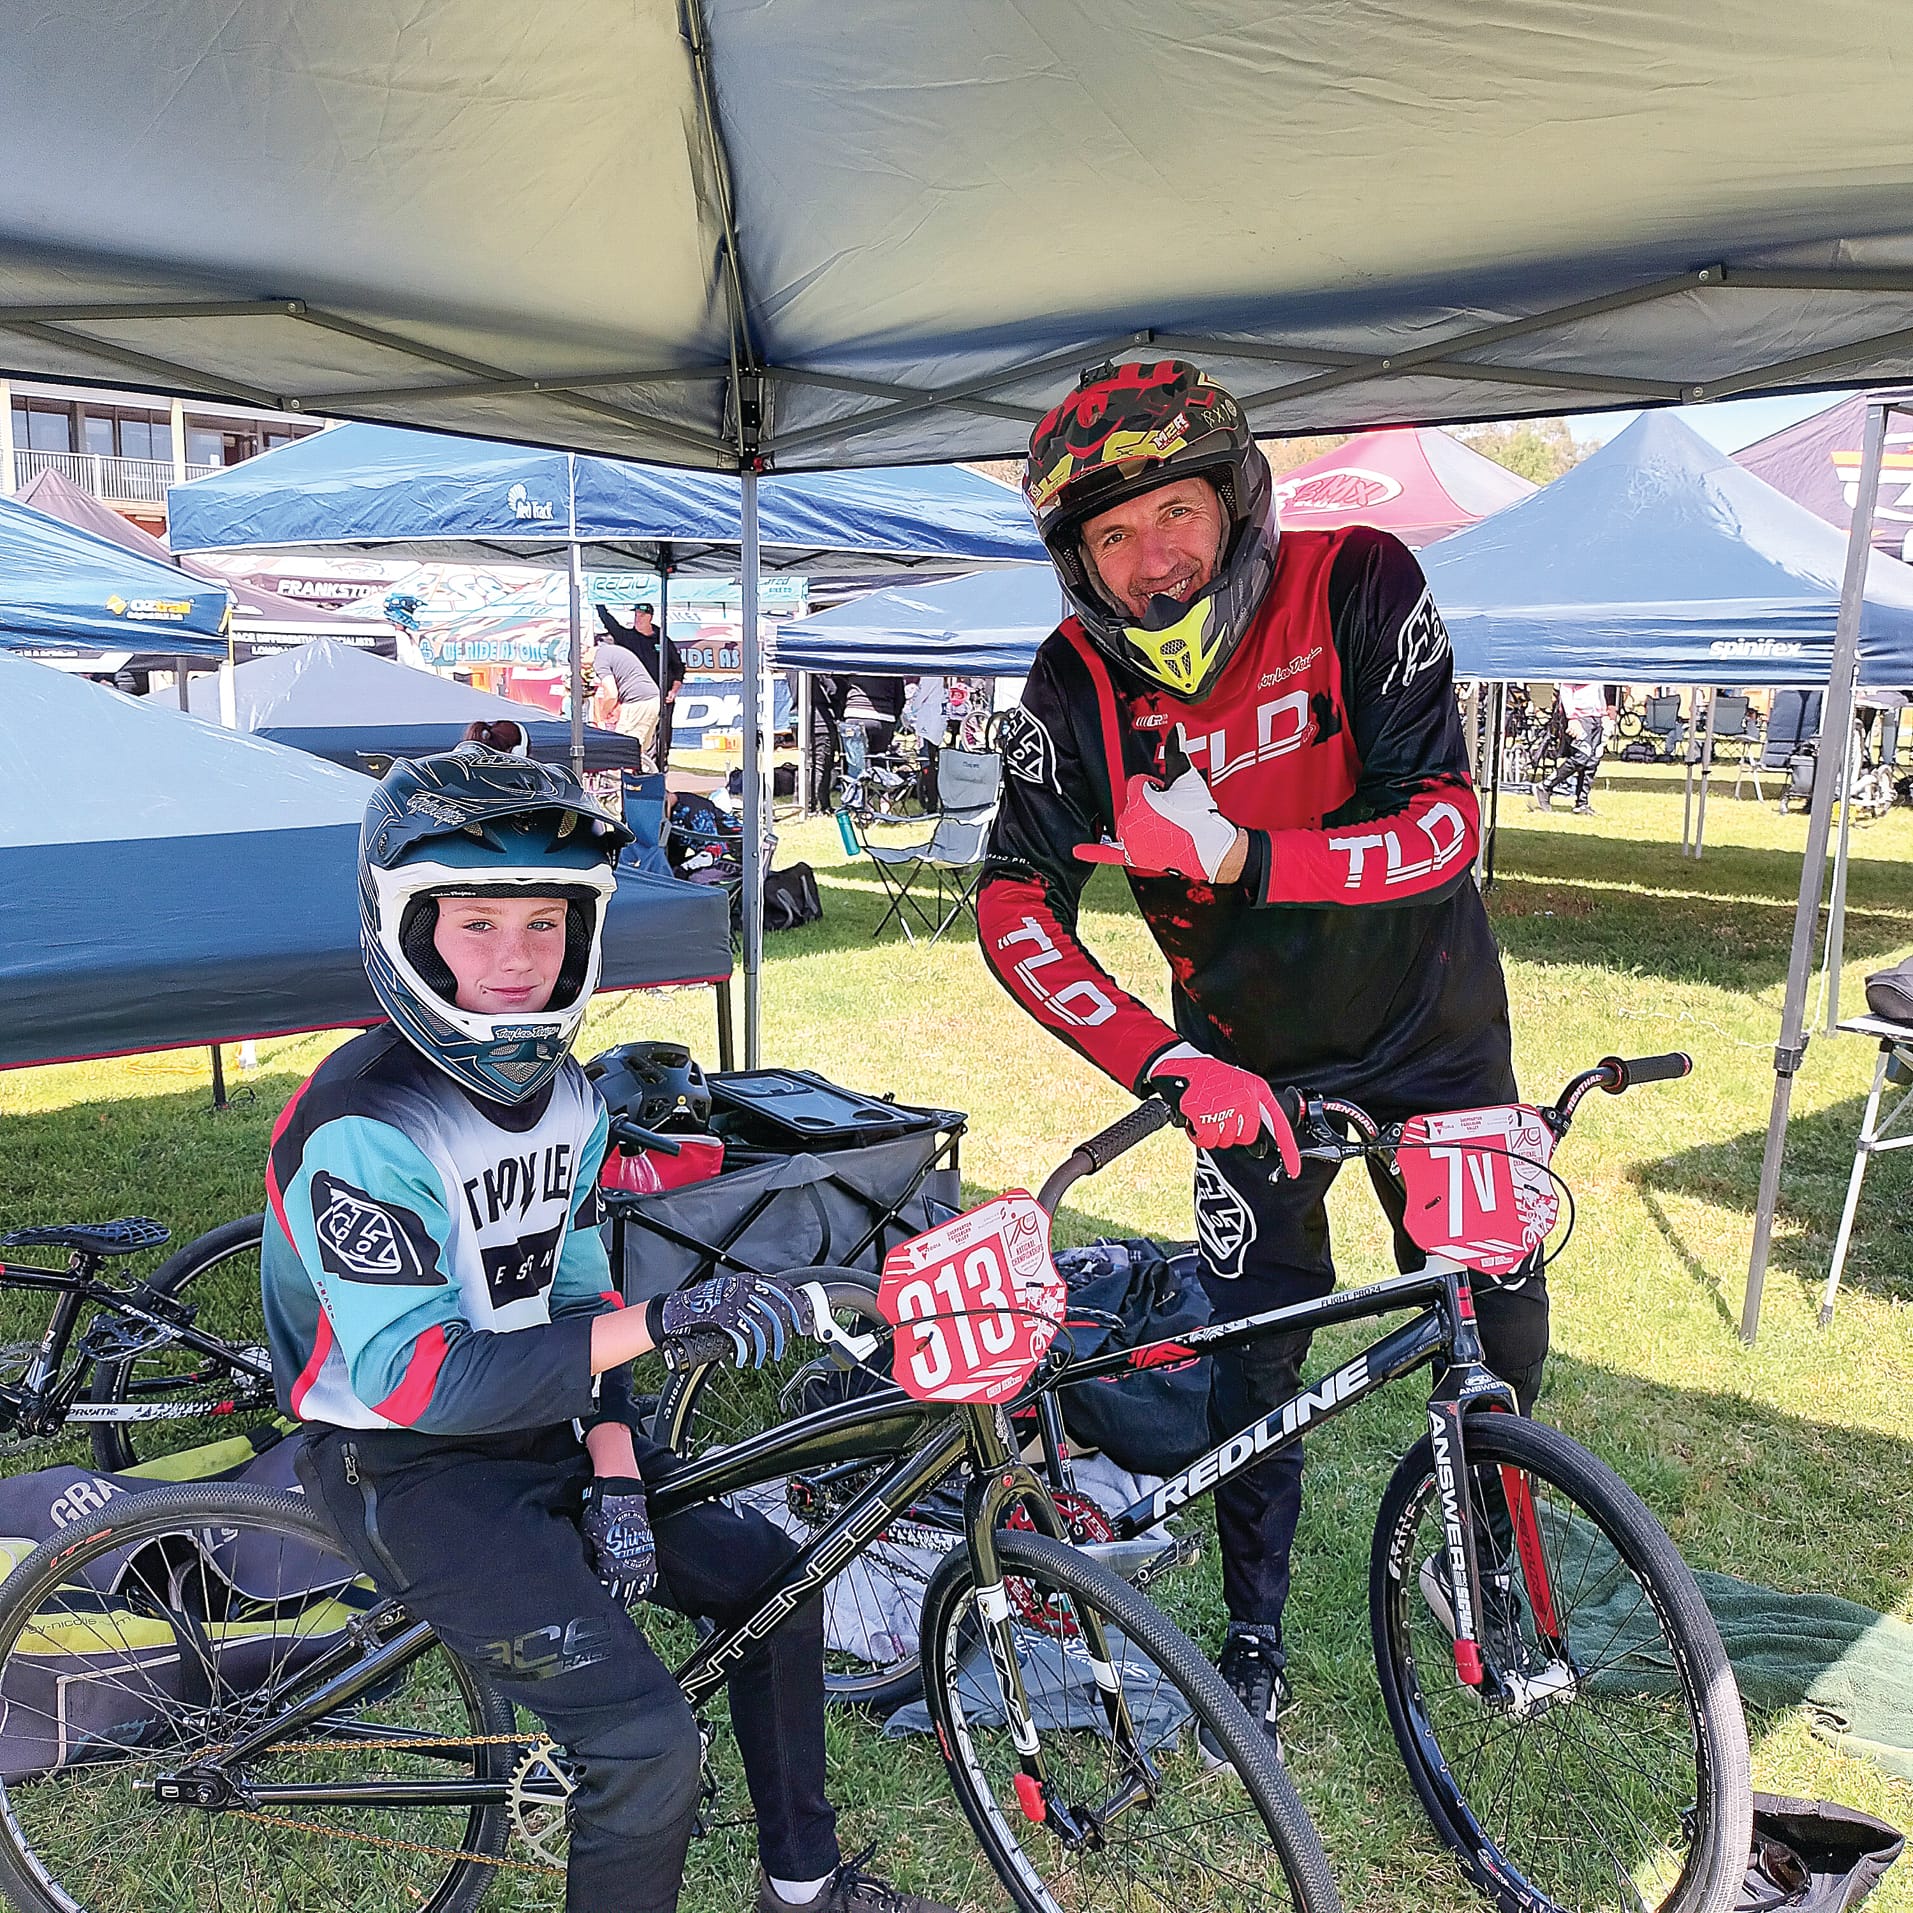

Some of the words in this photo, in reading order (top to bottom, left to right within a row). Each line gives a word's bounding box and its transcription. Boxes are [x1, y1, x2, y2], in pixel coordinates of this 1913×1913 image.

[1708, 637, 1802, 661] spinifex
[1328, 801, 1466, 889] TLD
[997, 916, 1118, 1027] TLD
[1199, 1108, 1235, 1125] THOR
[896, 1245, 1017, 1390] 313
[668, 1373, 686, 1407] TIOGA
[1153, 1354, 1371, 1520] REDLINE
[1428, 1410, 1466, 1572] ANSWER
[679, 1497, 891, 1704] NTENSE
